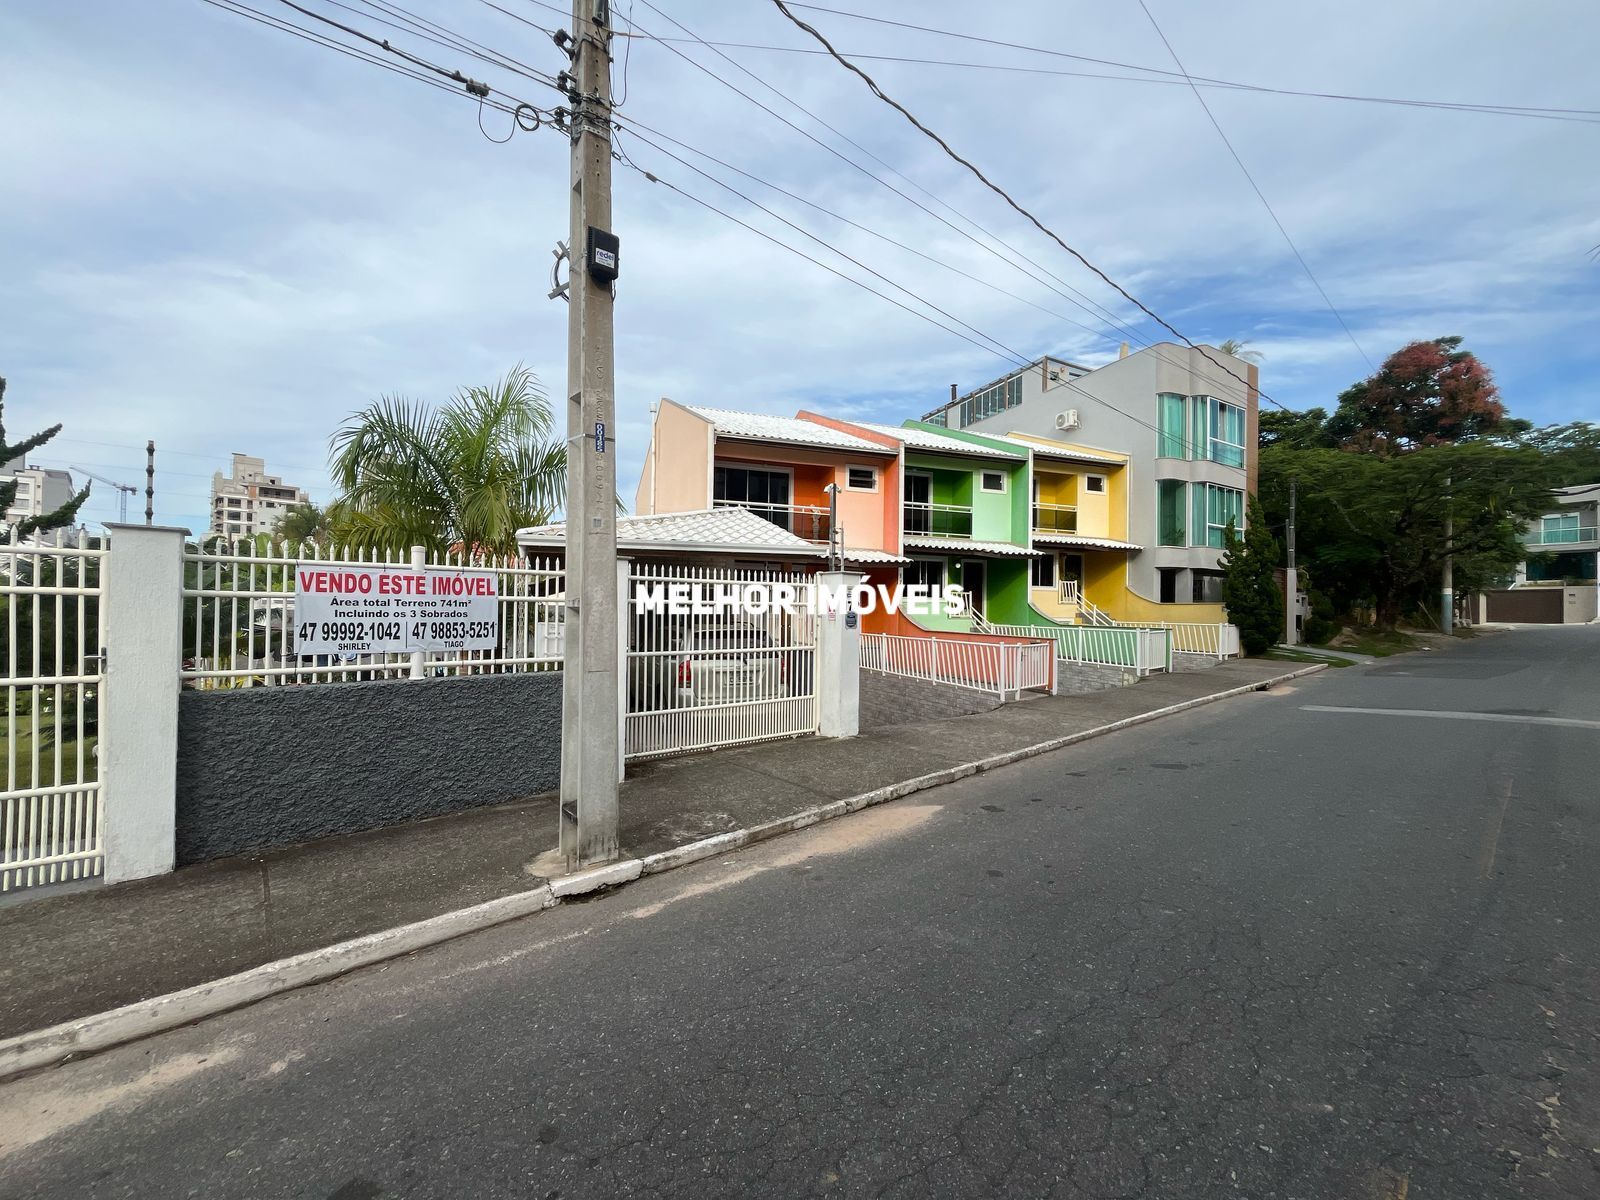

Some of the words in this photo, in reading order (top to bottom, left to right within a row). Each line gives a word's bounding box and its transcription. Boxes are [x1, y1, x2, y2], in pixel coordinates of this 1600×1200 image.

[300, 572, 372, 593] VENDO
[379, 575, 426, 594] ESTE
[432, 573, 495, 596] IMÓVEL
[331, 596, 359, 607] Área
[363, 598, 390, 607] total
[394, 599, 437, 607] Terreno
[440, 600, 471, 608] 741m²
[334, 610, 389, 618] Incluindo
[410, 610, 416, 618] 3
[420, 610, 468, 618] Sobrados
[299, 623, 317, 641] 47
[322, 622, 400, 640] 99992-1042
[412, 622, 427, 639] 47
[431, 622, 495, 639] 98853-5251
